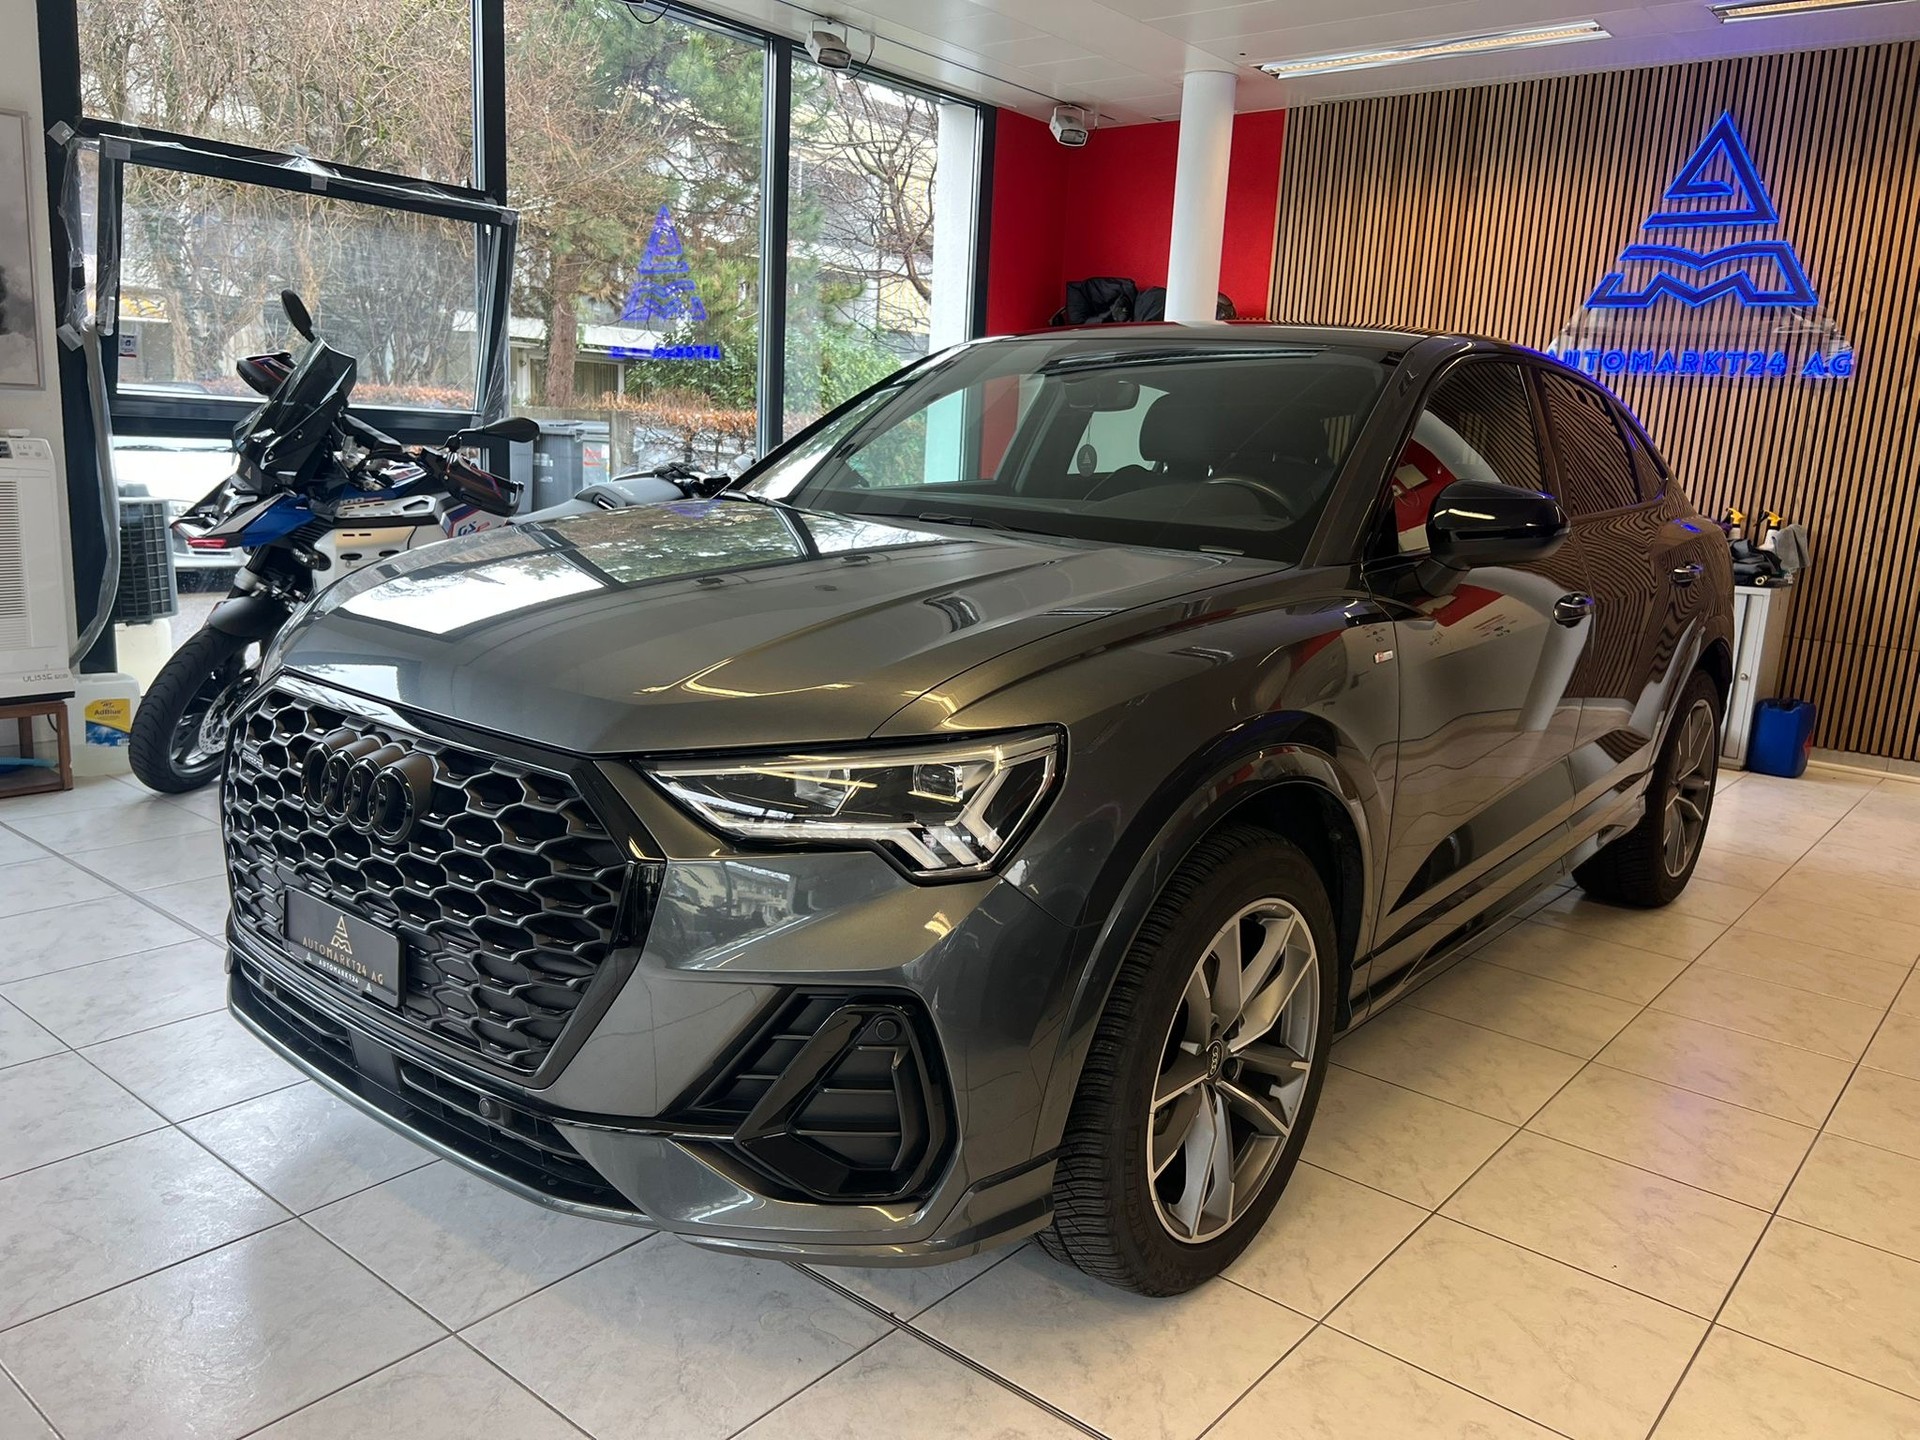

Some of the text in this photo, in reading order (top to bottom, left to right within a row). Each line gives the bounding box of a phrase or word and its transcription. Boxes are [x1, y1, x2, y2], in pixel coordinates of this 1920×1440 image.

[1802, 350, 1855, 377] AG
[22, 673, 53, 682] ULISSE
[302, 936, 384, 985] AUTOMARKT24 AG
[318, 959, 359, 984] AUTOMARKT24
